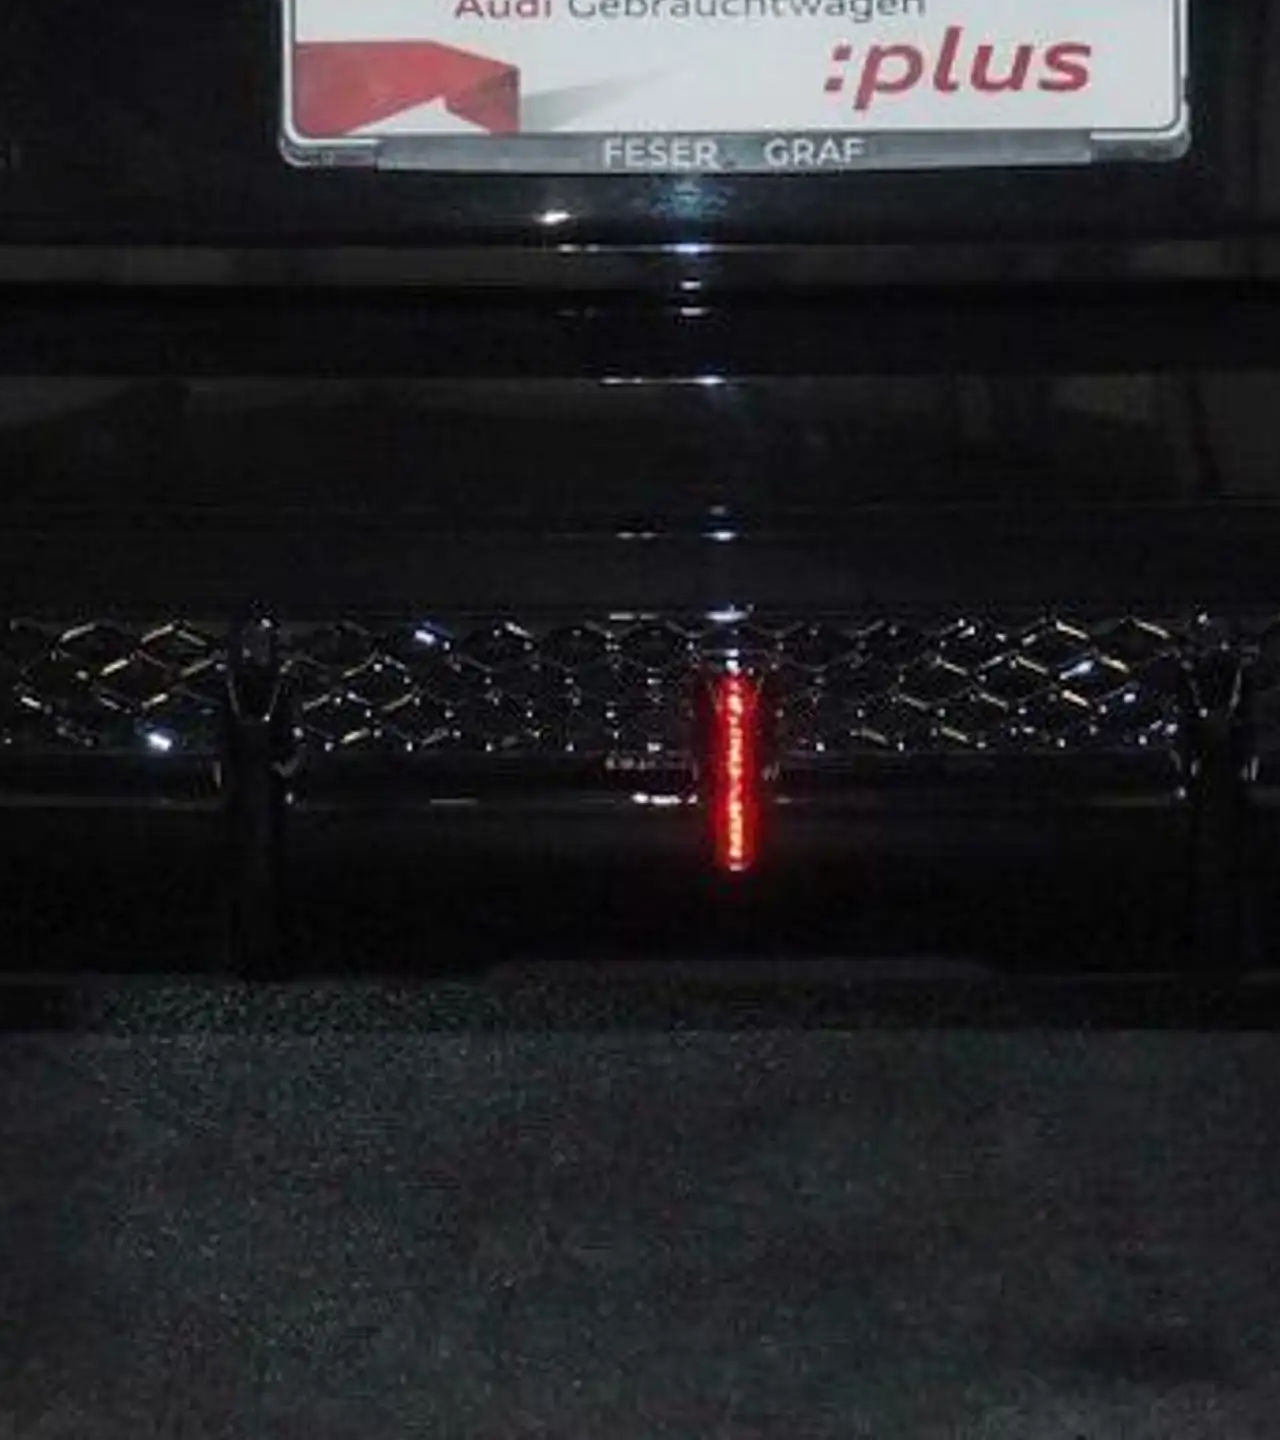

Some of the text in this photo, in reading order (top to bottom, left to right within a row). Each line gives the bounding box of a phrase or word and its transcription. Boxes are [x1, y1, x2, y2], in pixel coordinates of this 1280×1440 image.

[824, 25, 1092, 110] :plus
[604, 137, 867, 169] FESER GRAF
